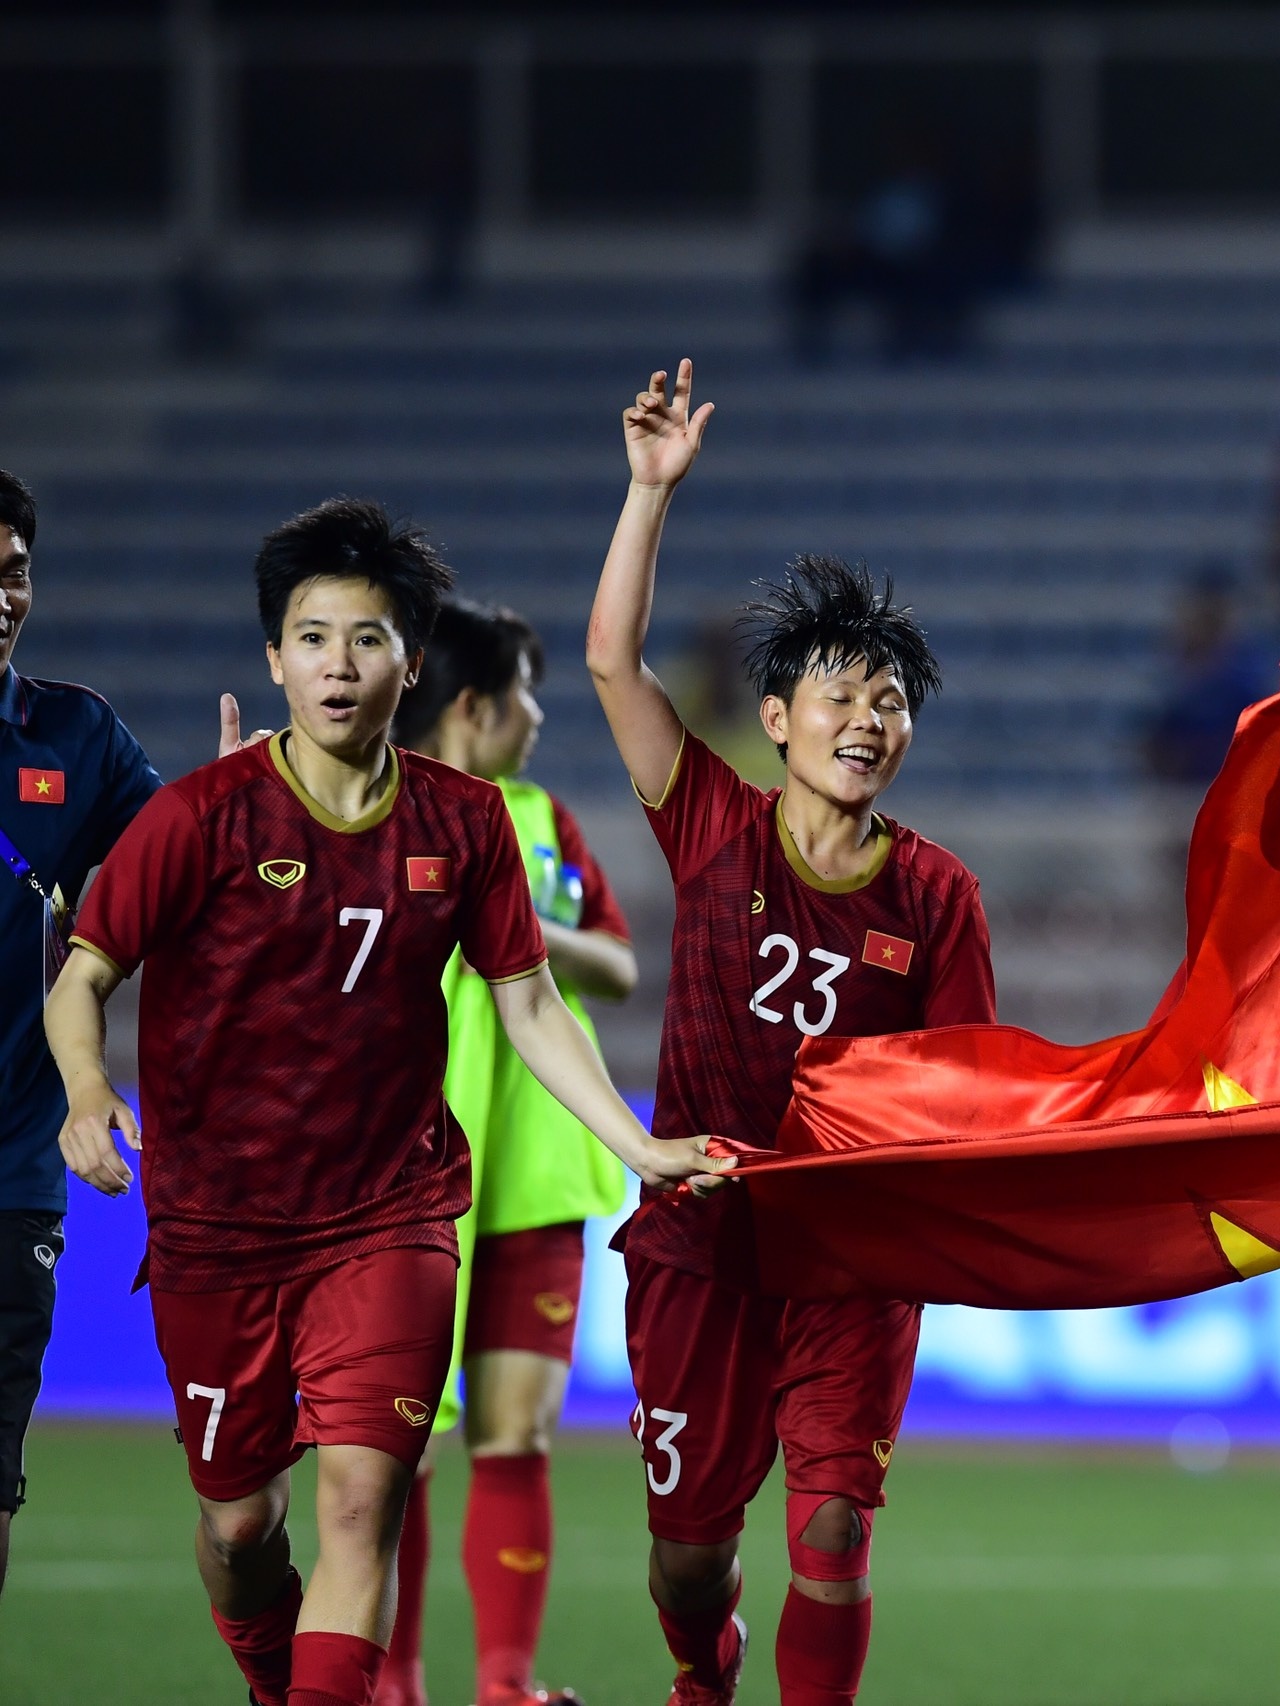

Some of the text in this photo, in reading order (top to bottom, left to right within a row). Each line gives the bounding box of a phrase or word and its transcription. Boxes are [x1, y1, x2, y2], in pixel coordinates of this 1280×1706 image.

[338, 906, 384, 993] 7
[749, 933, 851, 1037] 23
[186, 1382, 226, 1462] 7
